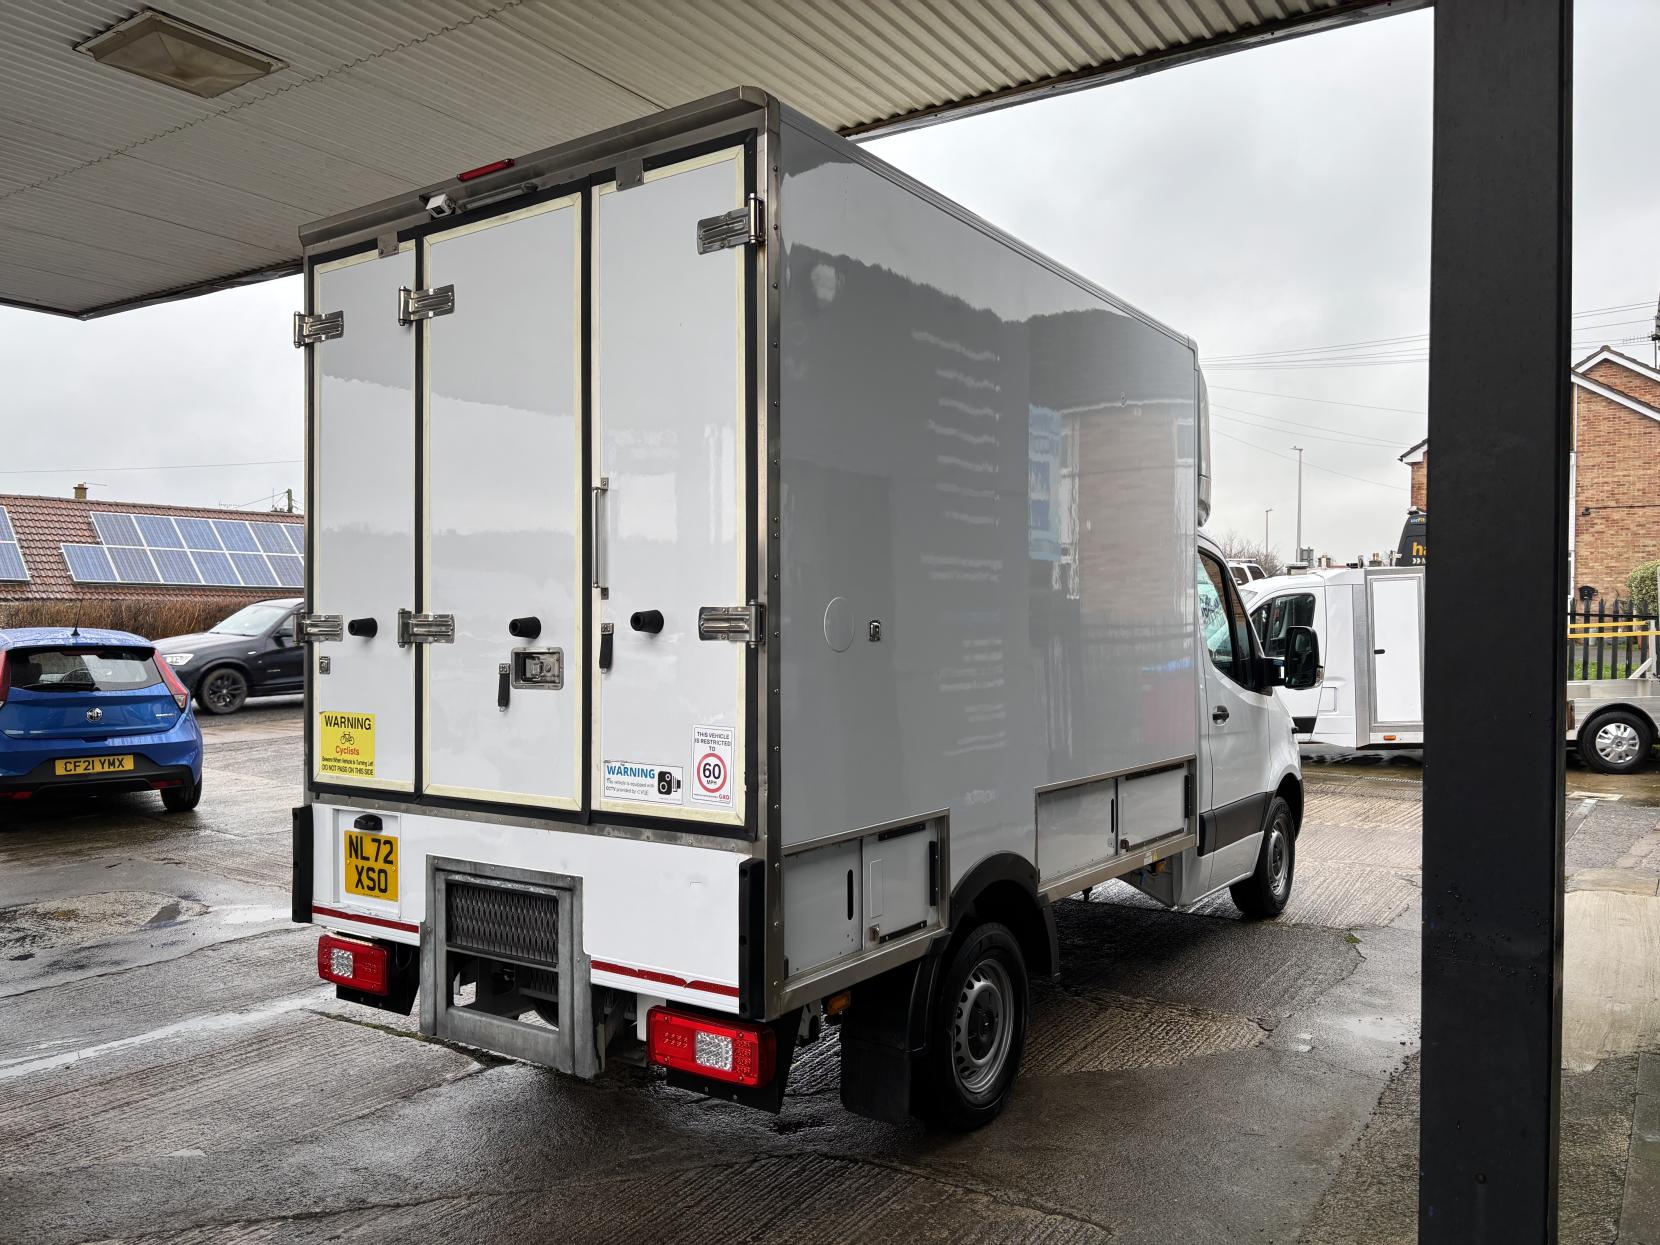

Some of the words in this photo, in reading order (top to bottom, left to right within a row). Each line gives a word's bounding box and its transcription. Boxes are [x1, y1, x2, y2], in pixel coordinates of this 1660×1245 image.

[324, 715, 372, 730] WARNING
[700, 738, 731, 747] RESTRICTED
[709, 732, 730, 740] VEHICLE
[336, 746, 360, 756] Cyclists
[64, 759, 96, 772] CF21
[98, 757, 125, 770] YMX
[355, 767, 364, 775] THIS
[364, 768, 374, 776] SIDE
[606, 765, 656, 778] WARNING
[702, 762, 722, 780] 60
[348, 834, 394, 865] NL72
[354, 864, 388, 894] XSO
